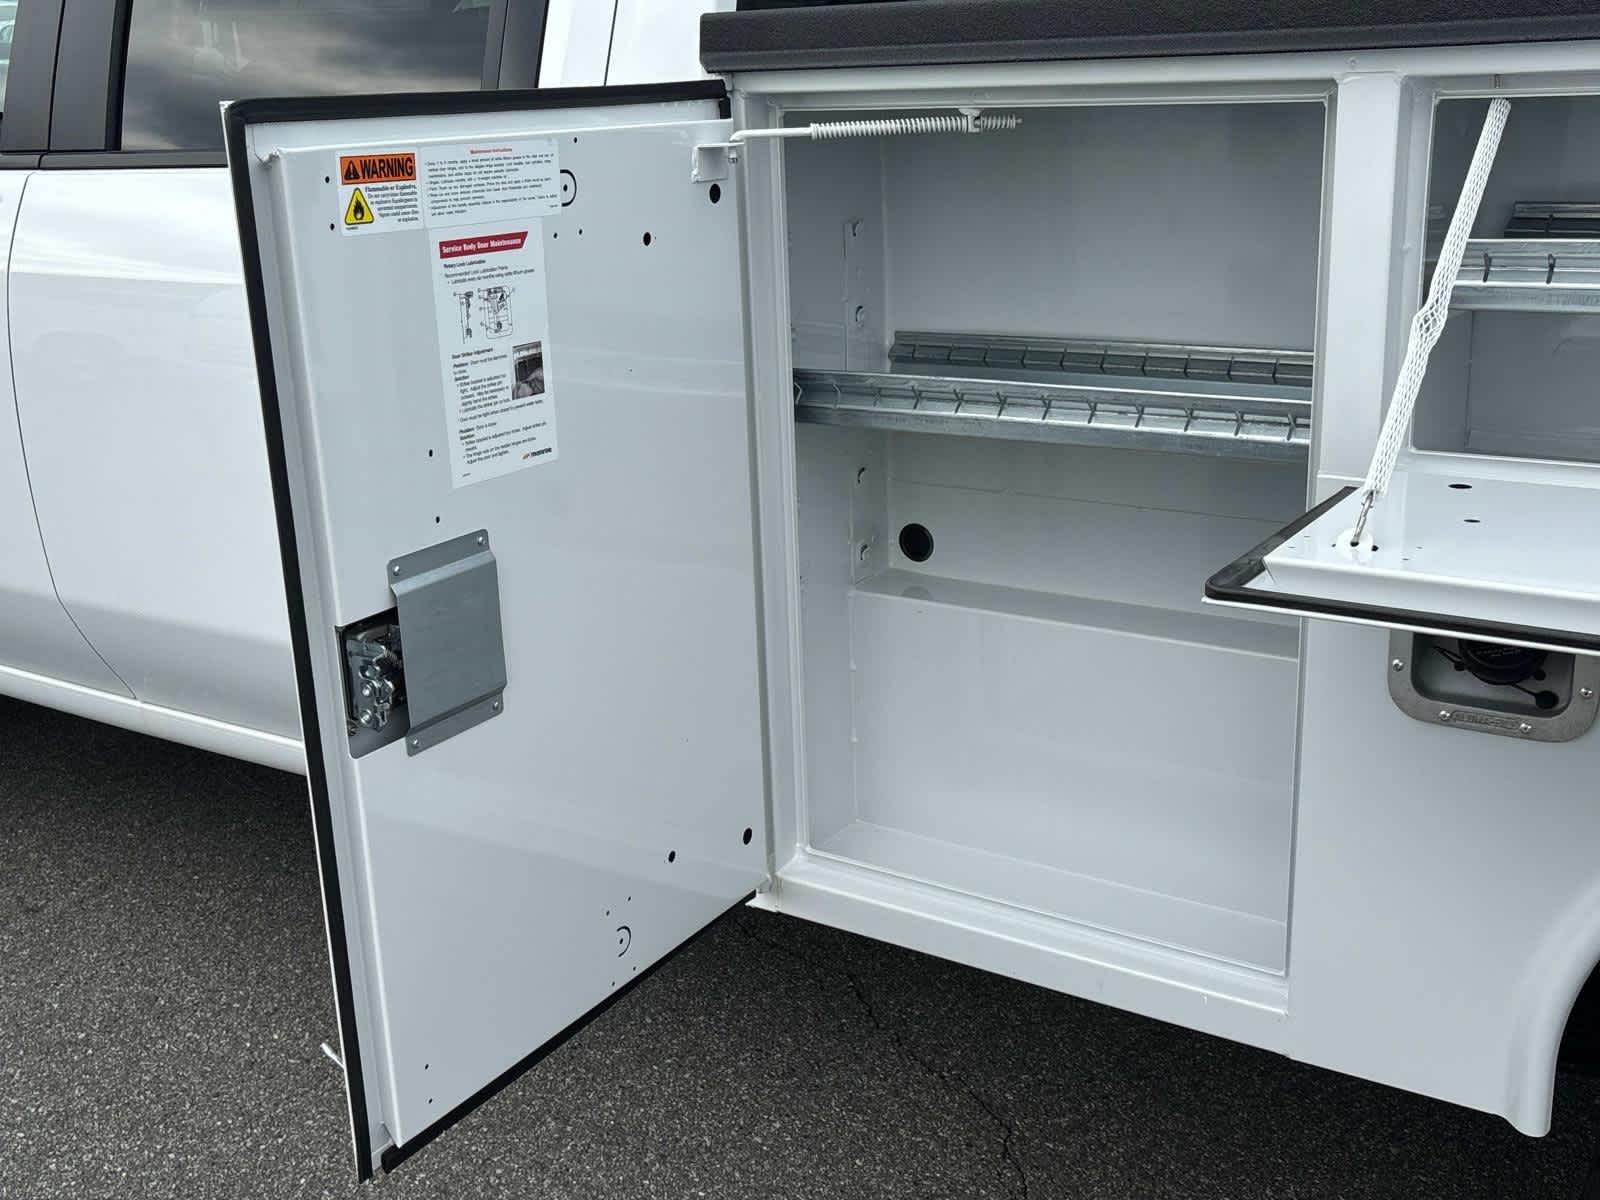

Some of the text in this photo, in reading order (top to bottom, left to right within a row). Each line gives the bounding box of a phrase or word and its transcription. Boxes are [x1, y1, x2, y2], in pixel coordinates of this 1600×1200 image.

[360, 157, 413, 180] WARNING
[442, 238, 522, 254] Service Body Door Maintenance
